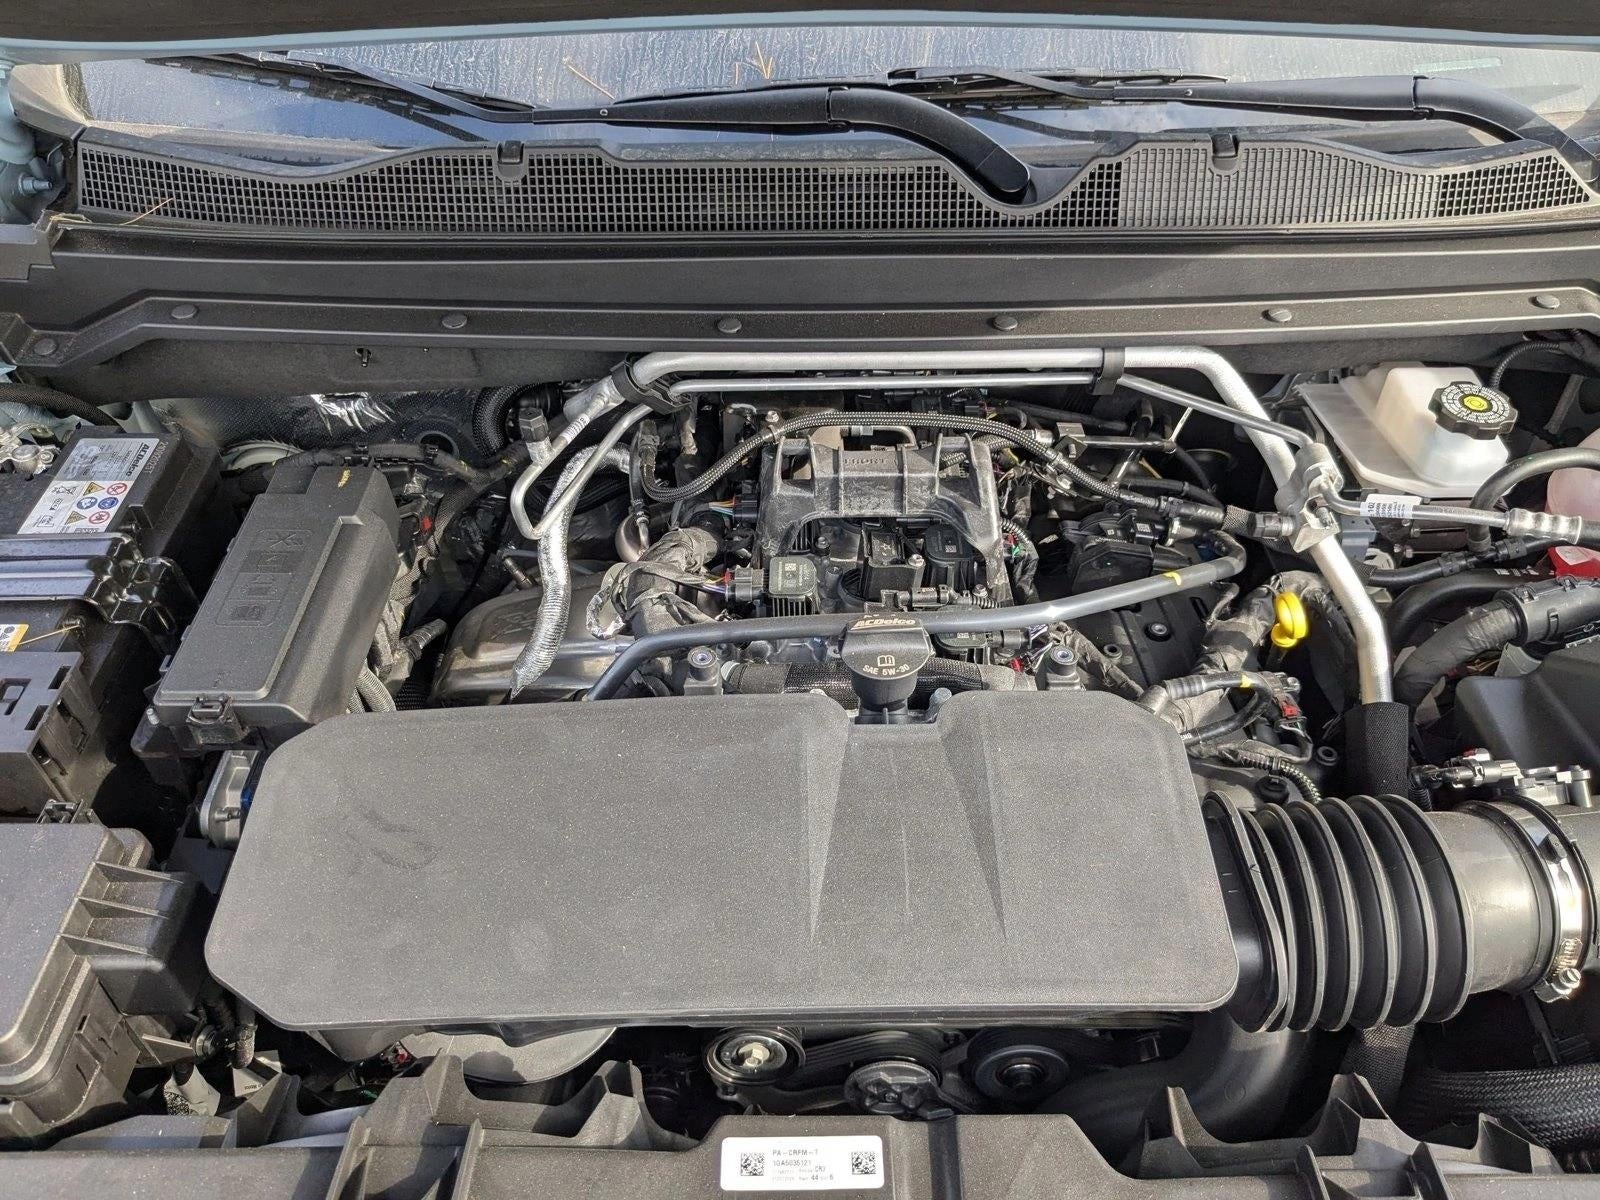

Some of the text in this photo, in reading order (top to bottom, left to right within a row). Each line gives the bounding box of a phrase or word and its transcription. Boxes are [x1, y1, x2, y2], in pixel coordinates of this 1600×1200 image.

[125, 442, 151, 477] ACDelco
[853, 618, 916, 628] ACDelco
[863, 663, 910, 676] SAE 5W-30
